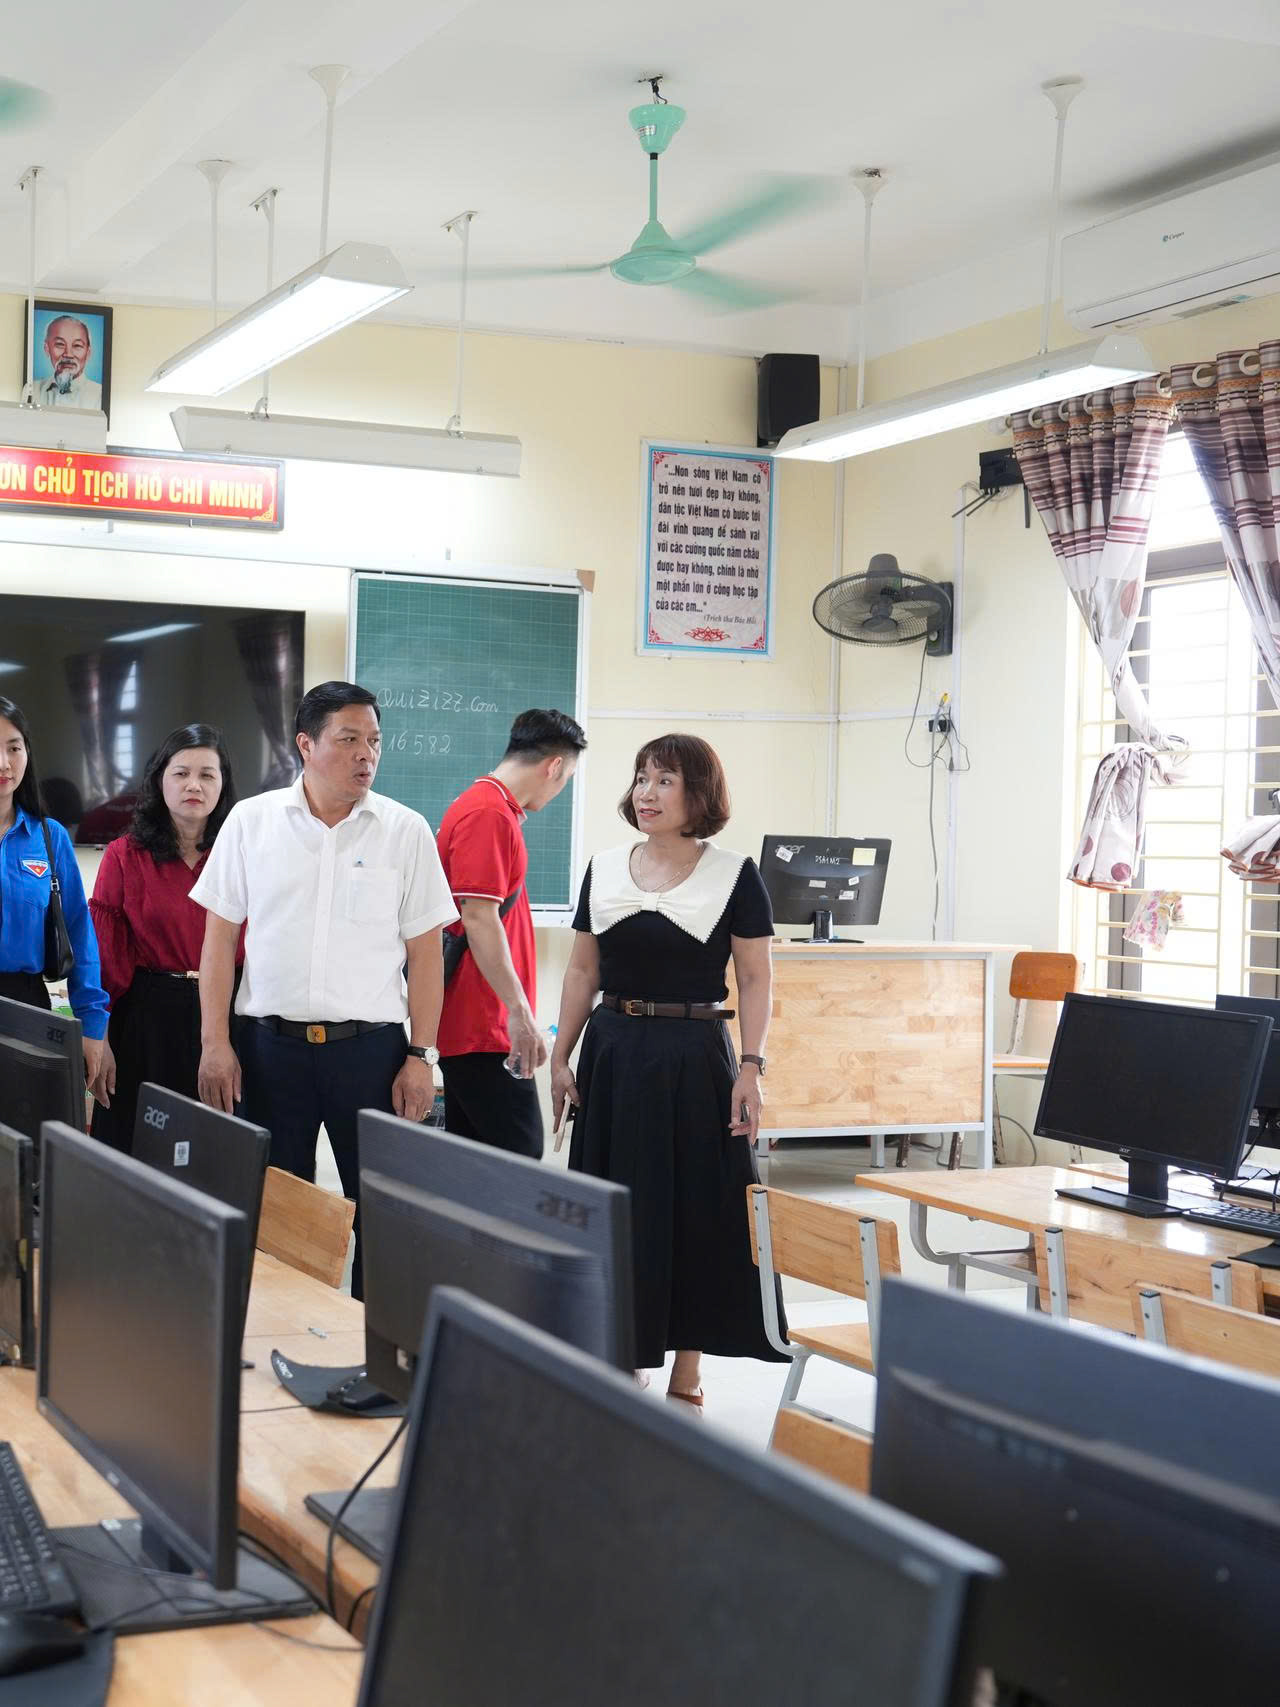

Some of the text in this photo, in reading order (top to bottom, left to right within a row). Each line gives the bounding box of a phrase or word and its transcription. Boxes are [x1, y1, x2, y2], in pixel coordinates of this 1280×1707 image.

[33, 456, 76, 495] CHỦ
[82, 468, 128, 503] TỊCH
[209, 478, 264, 510] MINH
[714, 468, 728, 483] Việt
[732, 470, 748, 482] Nam
[722, 488, 735, 502] hay
[688, 503, 701, 519] Việt
[703, 505, 719, 518] Nam
[692, 525, 713, 538] quang
[750, 529, 760, 541] vai
[676, 561, 689, 575] hay
[732, 584, 746, 599] học
[144, 1105, 170, 1130] acer
